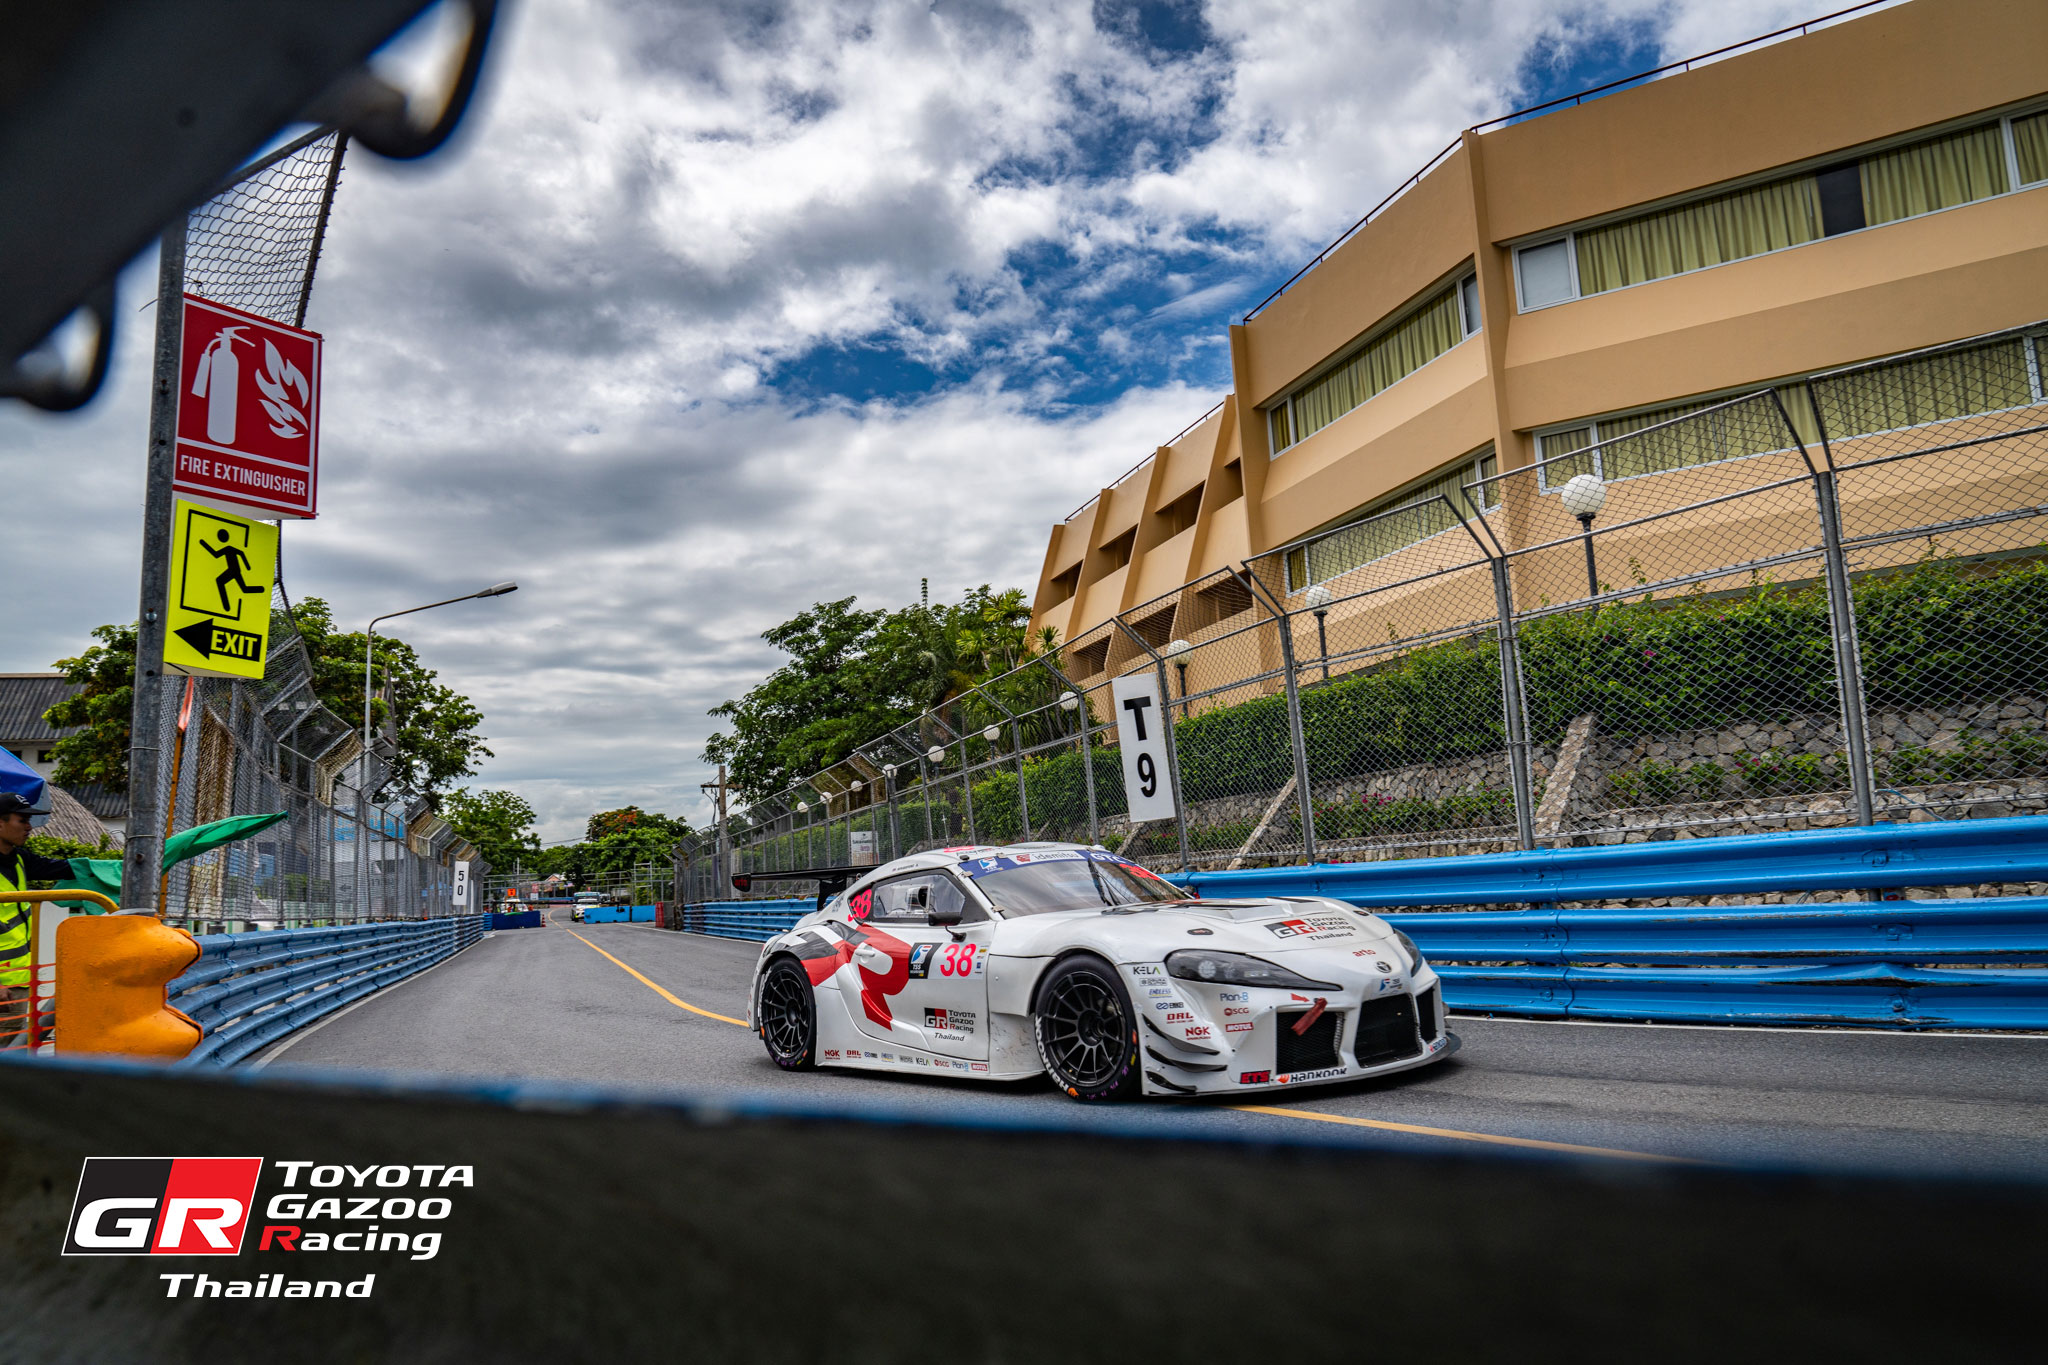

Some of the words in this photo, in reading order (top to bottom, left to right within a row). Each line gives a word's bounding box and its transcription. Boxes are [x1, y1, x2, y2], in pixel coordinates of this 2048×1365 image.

[181, 455, 210, 476] FIRE
[214, 462, 306, 496] EXTINGUISHER
[211, 631, 258, 658] EXIT
[1033, 851, 1080, 860] idemitsu
[1273, 924, 1315, 939] GR
[1307, 932, 1354, 941] Thailand
[940, 943, 977, 977] 38
[1220, 992, 1249, 1001] Plan-B
[948, 1009, 976, 1018] TOYOTA
[1232, 1007, 1249, 1015] SCG
[925, 1015, 948, 1029] GR
[949, 1017, 974, 1025] GAZOO
[949, 1023, 974, 1034] Racing
[1185, 1027, 1211, 1036] NGK
[1226, 1023, 1253, 1031] MOTUL
[934, 1032, 965, 1041] Thailand
[824, 1049, 840, 1057] NGK
[1240, 1071, 1270, 1084] ETS
